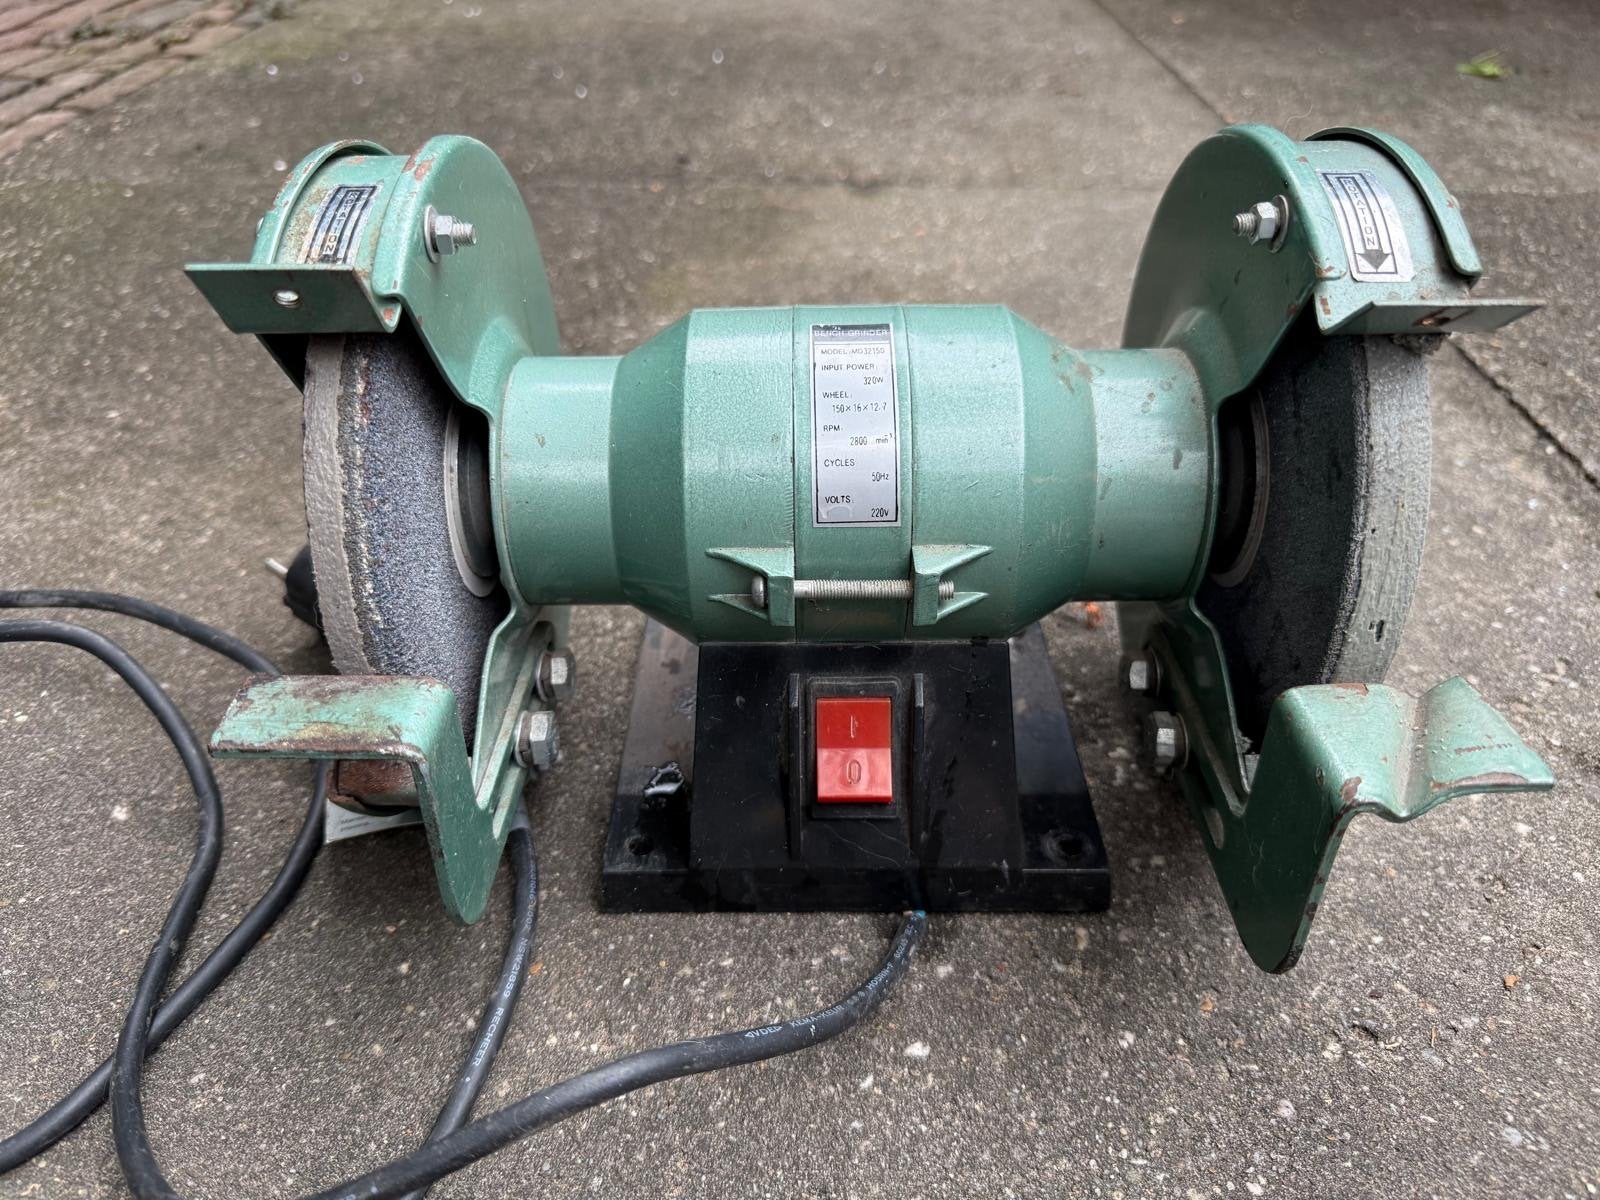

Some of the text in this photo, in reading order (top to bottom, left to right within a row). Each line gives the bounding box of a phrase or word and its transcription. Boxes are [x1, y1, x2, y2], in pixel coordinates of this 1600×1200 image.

[1343, 178, 1376, 247] ROTATION
[863, 376, 884, 386] 320W
[850, 436, 868, 446] 2800
[871, 472, 889, 482] 50Hz
[472, 1007, 505, 1067] RECHEER
